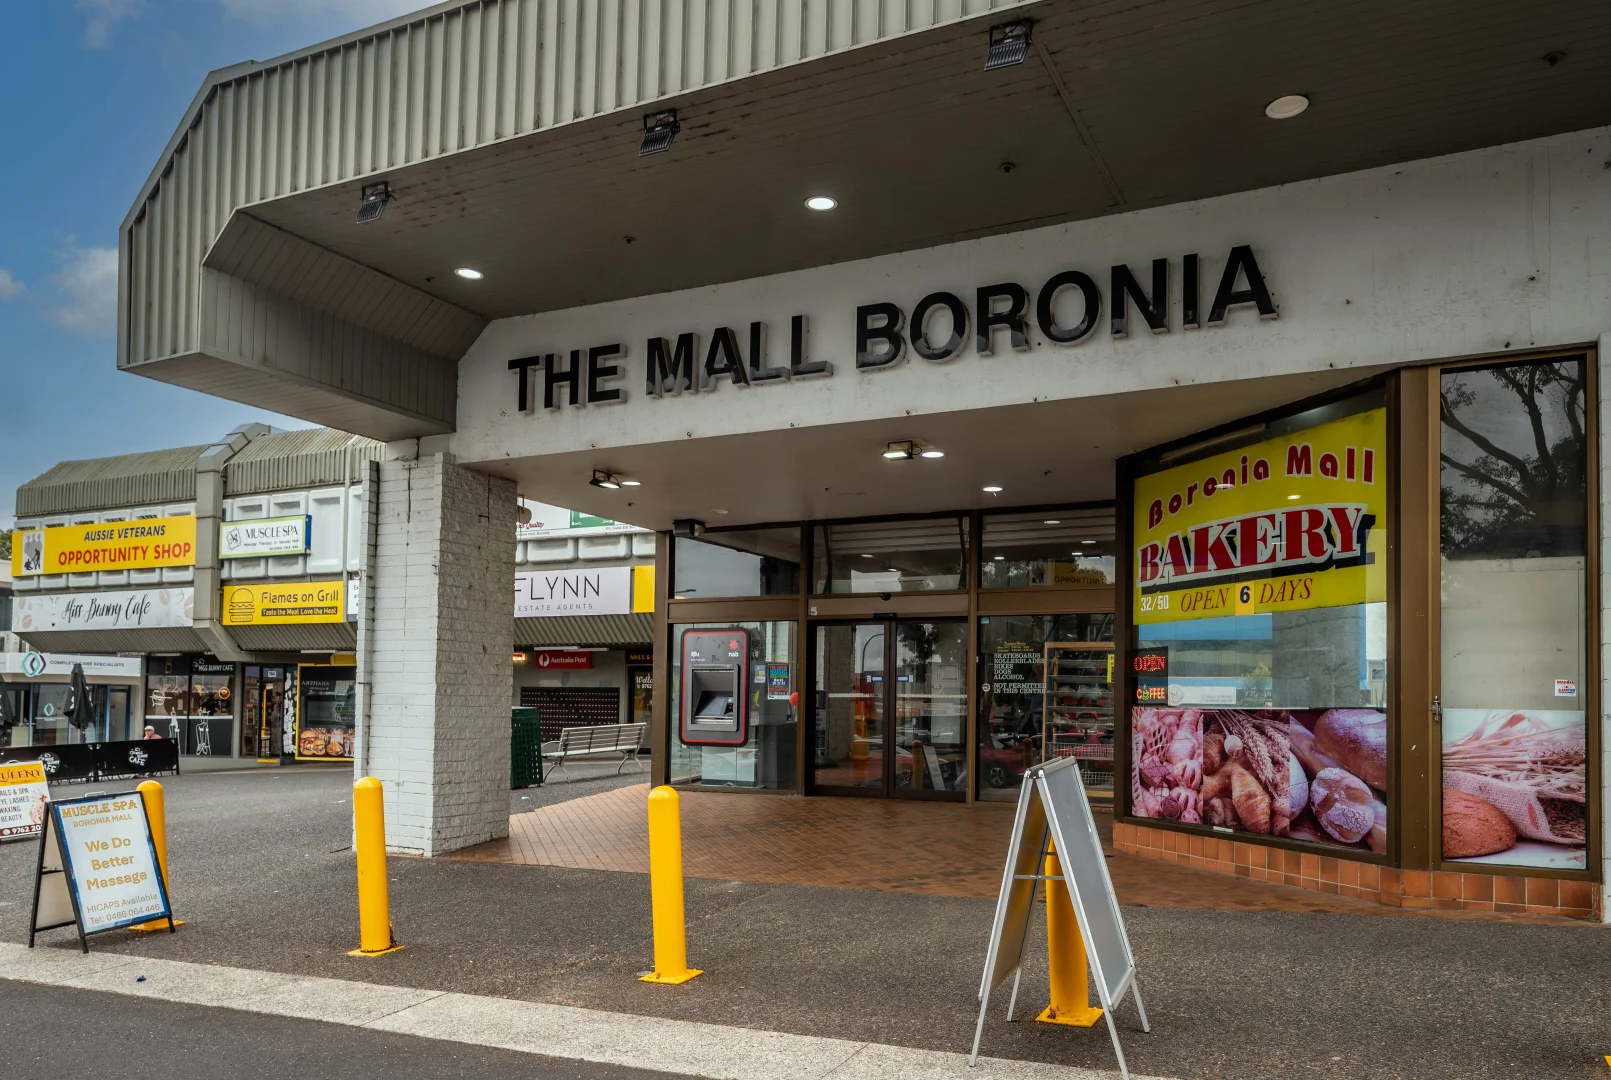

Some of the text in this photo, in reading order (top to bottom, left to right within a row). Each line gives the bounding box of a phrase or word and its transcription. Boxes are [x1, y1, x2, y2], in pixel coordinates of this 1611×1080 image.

[508, 244, 1280, 414] THE MALL BORONIA
[1148, 442, 1376, 531] Boronia Mall
[84, 525, 166, 542] AUSSIE VETERANS
[246, 525, 299, 539] MUSCLE SPA
[1138, 503, 1368, 587] BAKERY
[58, 542, 191, 566] OPPORTUNITY SHOP
[261, 590, 338, 604] Flames on Grill
[1181, 577, 1313, 612] OPEN 6 DAYS
[62, 594, 151, 626] Miss Bunny Cafe
[1140, 595, 1169, 612] 32/50
[551, 656, 574, 664] Australia
[1134, 655, 1166, 671] OPEN
[43, 764, 56, 773] AFE
[129, 756, 146, 766] CAFE
[0, 769, 41, 782] UEENY
[61, 799, 138, 818] MUSCLE SPA
[1, 814, 22, 823] BEAUTY
[73, 814, 133, 828] BORONIA MALL
[12, 826, 30, 834] 9762
[85, 837, 132, 853] We Do
[91, 854, 134, 871] Better
[86, 870, 148, 891] Massage
[86, 892, 158, 914] HICAPS Available
[90, 904, 161, 925] Tel: 0466 064 446
